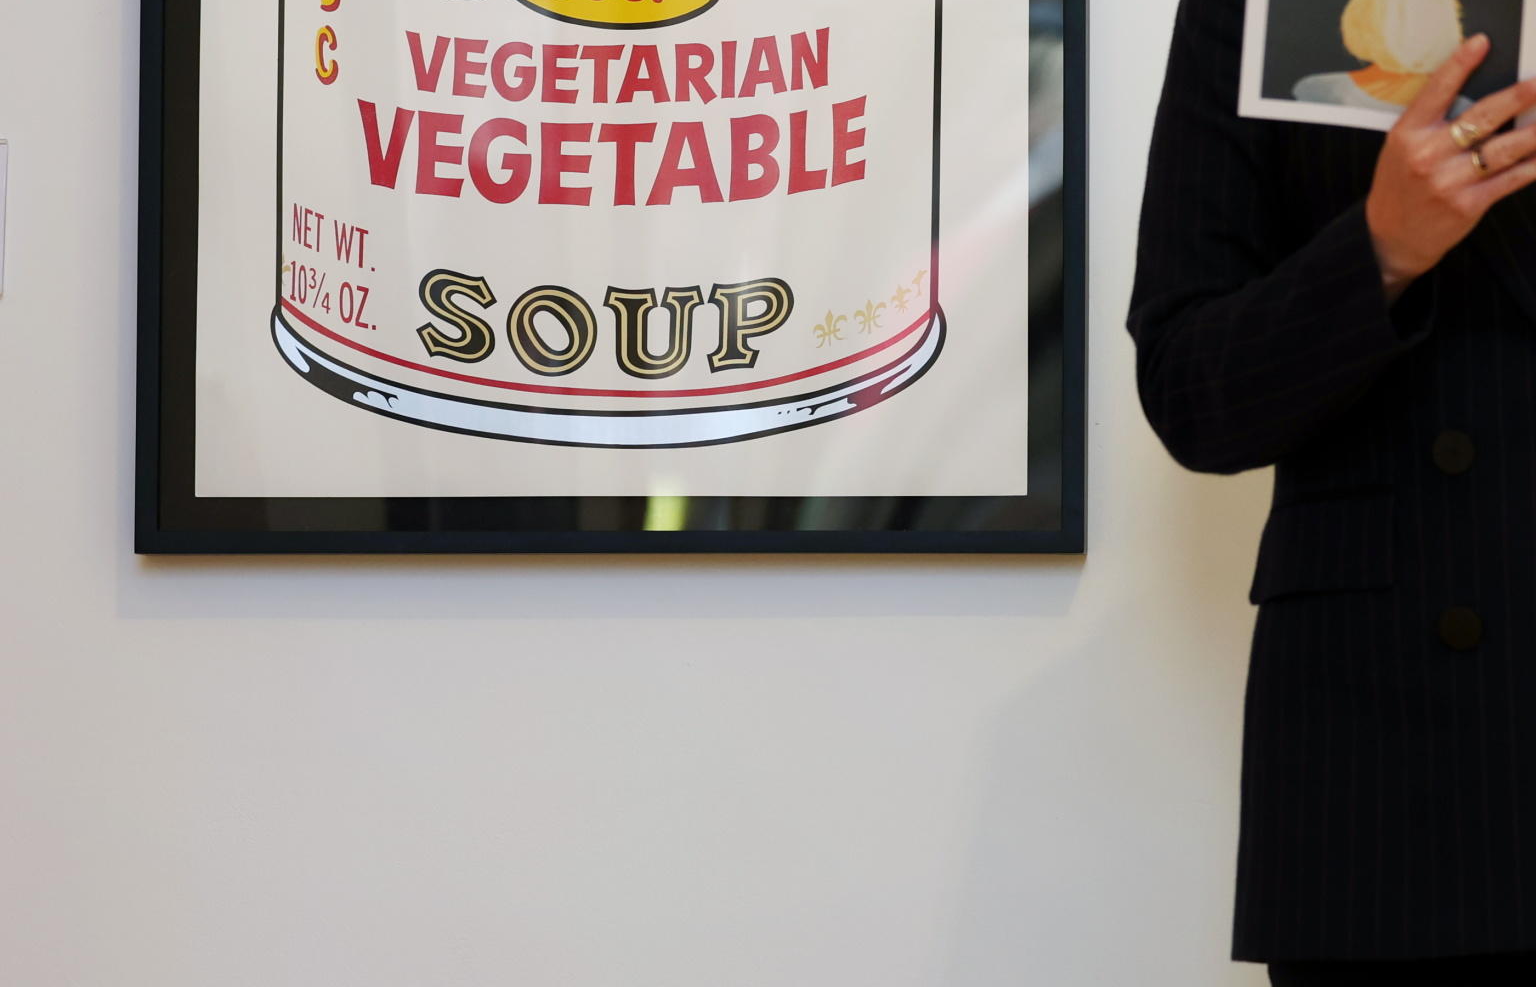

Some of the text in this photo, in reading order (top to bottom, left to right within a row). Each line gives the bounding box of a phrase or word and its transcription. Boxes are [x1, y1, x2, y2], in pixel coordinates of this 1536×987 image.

[405, 27, 830, 105] VEGETARIAN
[356, 94, 868, 207] VEGETABLE
[292, 202, 376, 272] NET WT.
[339, 281, 377, 330] OZ.
[415, 268, 795, 380] SOUP
